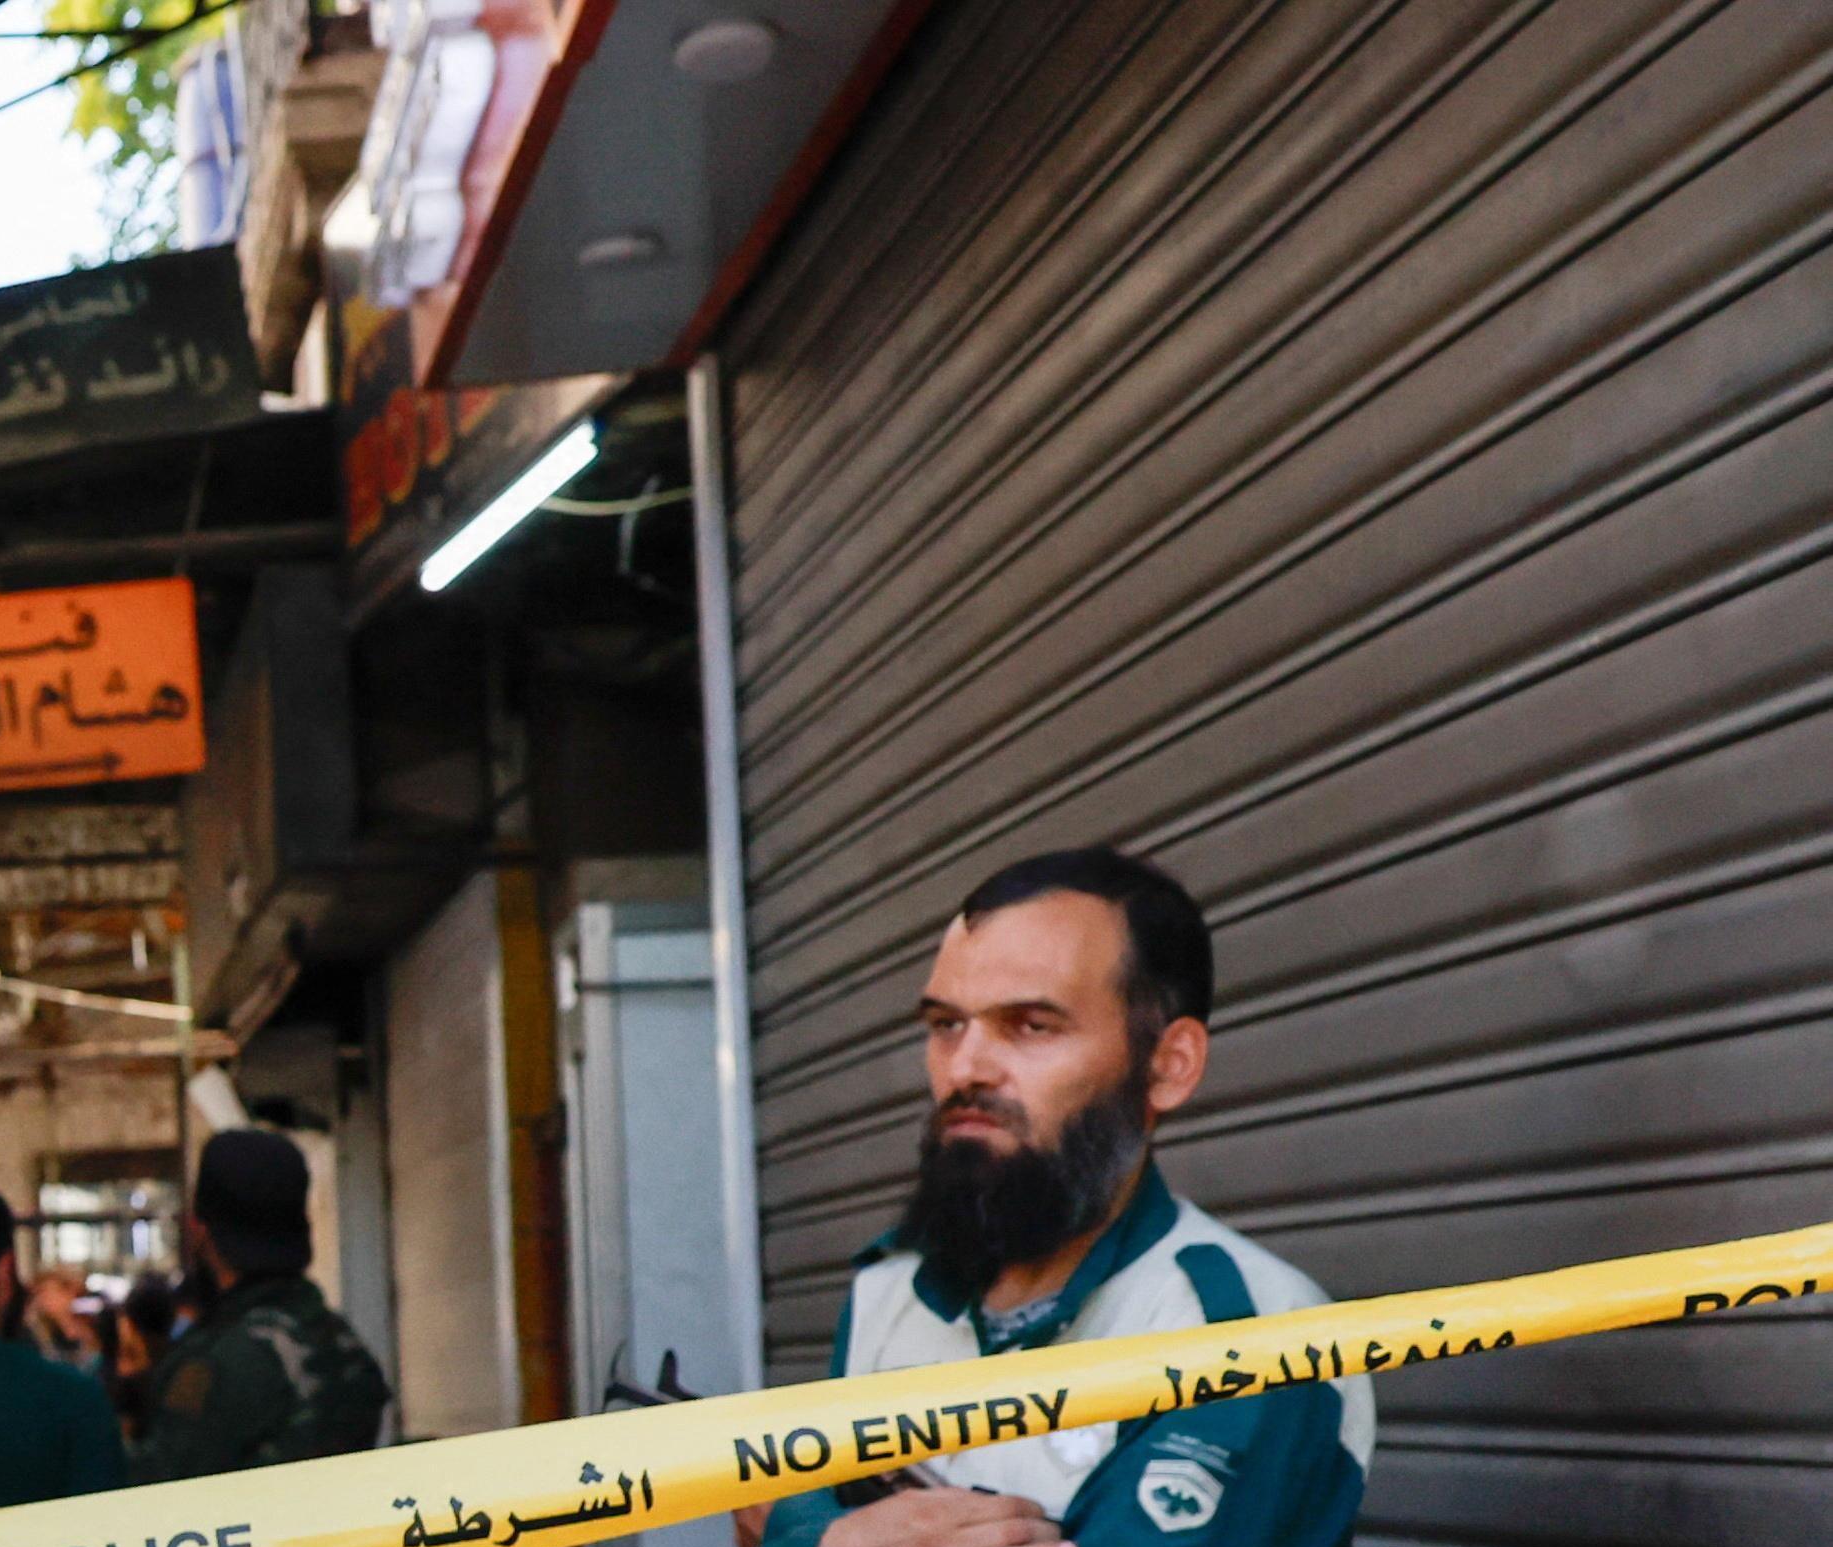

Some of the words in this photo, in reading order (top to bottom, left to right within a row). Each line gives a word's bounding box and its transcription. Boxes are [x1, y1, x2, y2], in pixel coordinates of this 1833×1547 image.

[33, 667, 190, 750] هشام
[734, 1427, 832, 1482] NO
[852, 1389, 1069, 1463] ENTRY
